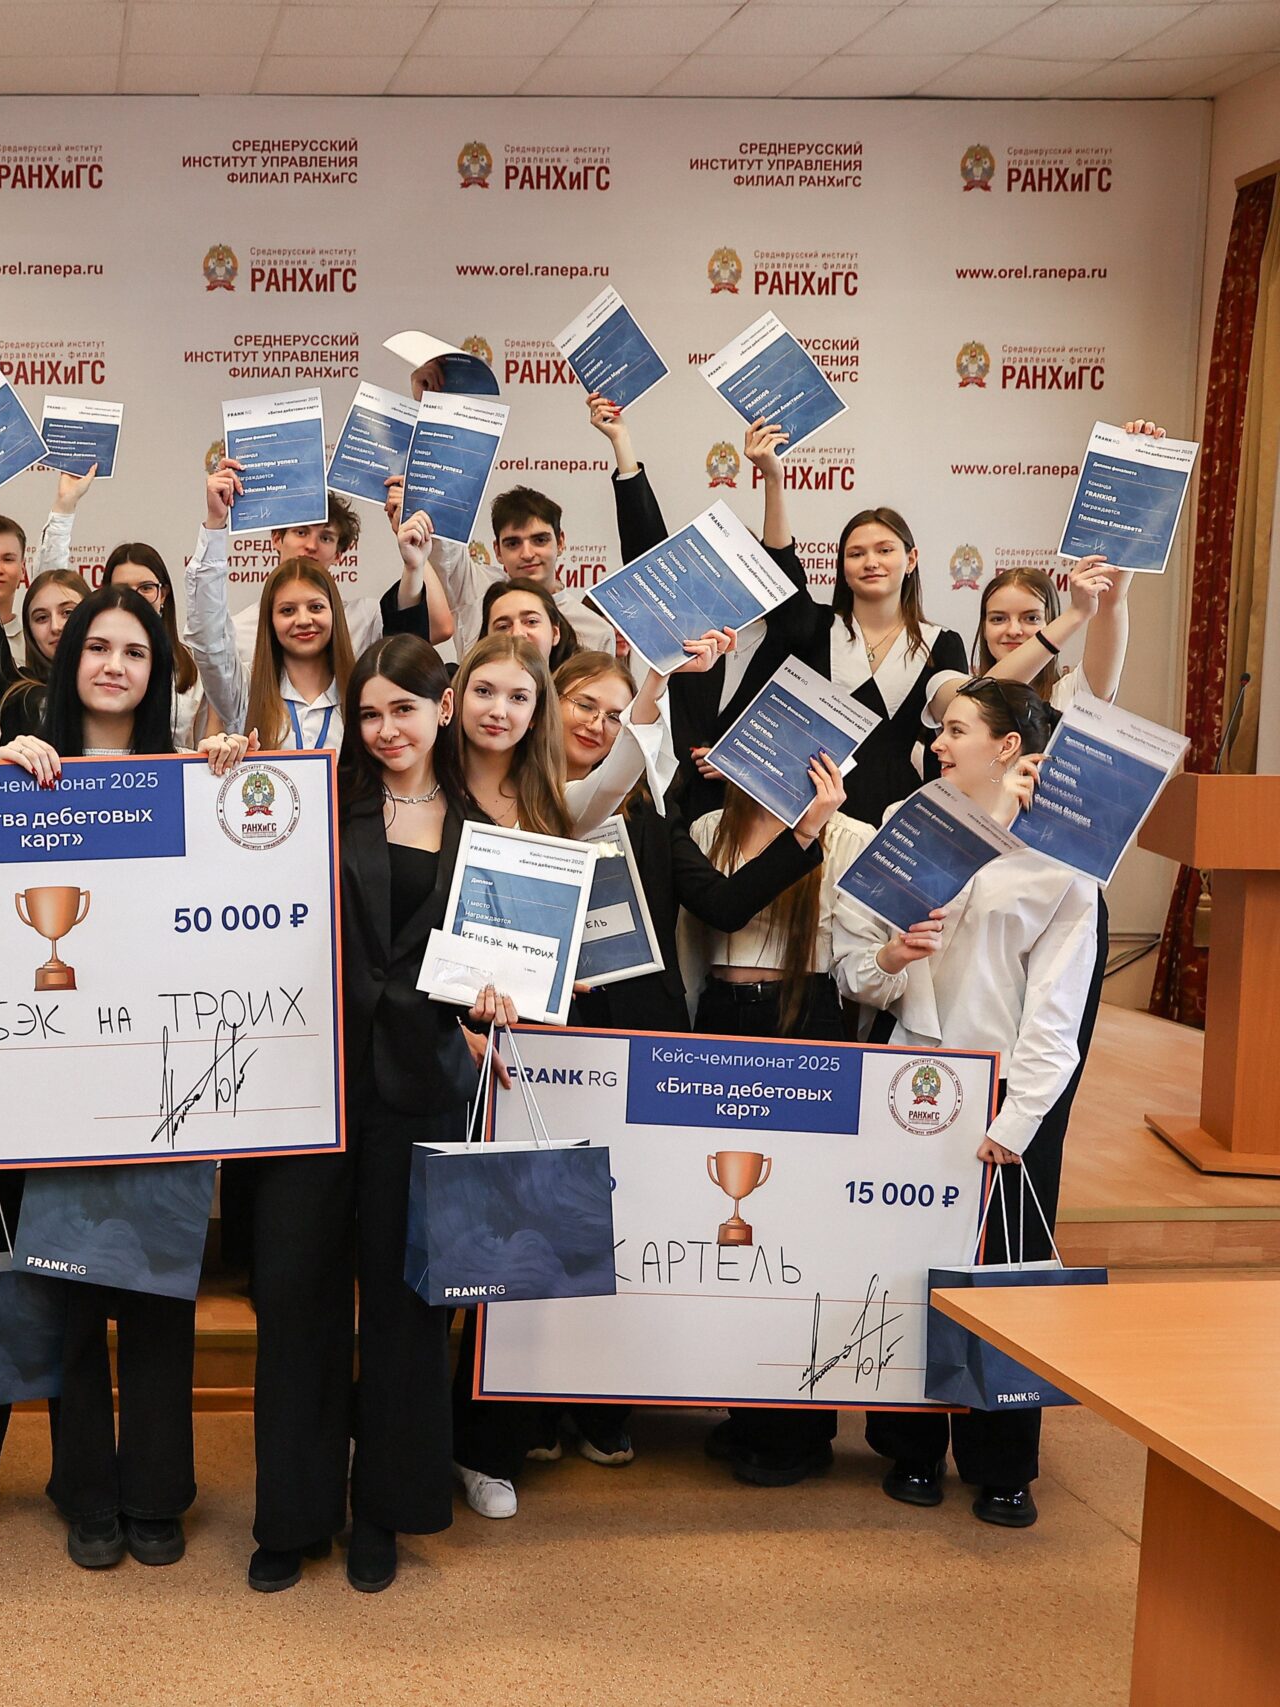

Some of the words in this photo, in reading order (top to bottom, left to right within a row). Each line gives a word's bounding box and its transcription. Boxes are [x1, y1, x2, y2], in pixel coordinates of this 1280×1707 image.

[65, 144, 103, 153] институт
[232, 138, 358, 152] СРЕДНЕРУССКИЙ
[739, 141, 862, 155] СРЕДНЕРУССКИЙ
[65, 156, 103, 164] филиал
[182, 156, 258, 168] ИНСТИТУТ
[261, 156, 358, 168] УПРАВЛЕНИЯ
[690, 159, 764, 171] ИНСТИТУТ
[768, 159, 862, 171] УПРАВЛЕНИЯ
[227, 172, 289, 184] ФИЛИАЛ
[294, 172, 358, 184] РАНХиГС
[504, 166, 610, 191] РАНХиГС
[733, 175, 795, 188] ФИЛИАЛ
[799, 175, 862, 188] РАНХиГС
[1007, 167, 1112, 192] РАНХиГС
[754, 250, 818, 259] Среднерусский
[822, 250, 858, 259] институт
[251, 268, 357, 292] РАНХиГС
[456, 262, 609, 280] www.orel.ranepa.ru
[956, 265, 1107, 281] www.orel.ranepa.ru
[754, 271, 858, 295] РАНХиГС
[234, 332, 359, 347] СРЕДНЕРУССКИЙ
[184, 351, 259, 363] ИНСТИТУТ
[262, 351, 359, 363] УПРАВЛЕНИЯ
[0, 361, 105, 385] РАНХиГС
[228, 367, 290, 379] ФИЛИАЛ
[295, 367, 359, 379] РАНХиГС
[1002, 366, 1104, 390] РАНХиГС
[1087, 480, 1112, 490] Команда
[1081, 502, 1120, 515] Награждается
[708, 512, 723, 531] FRANK
[1078, 514, 1109, 526] Полякова
[655, 556, 679, 583] Картель
[666, 550, 688, 574] Команда
[644, 564, 677, 600] Награждается
[632, 572, 660, 603] Широкова
[657, 598, 676, 620] Мария
[748, 718, 774, 739] Картель
[757, 709, 780, 729] Команда
[740, 728, 777, 756] Награждается
[763, 759, 784, 777] Мария
[110, 772, 159, 790] 2025
[32, 807, 153, 829] дебетовых
[242, 823, 277, 832] РАНХиГС
[20, 832, 83, 851] карт»
[889, 827, 915, 849] Картель
[174, 907, 212, 933] 50
[221, 904, 281, 930] 000
[290, 903, 309, 927] ₽
[465, 910, 512, 924] Награждается
[522, 945, 554, 959] ТРОИХ
[158, 987, 306, 1032] ТРОИХ
[651, 1047, 795, 1071] Кейс-чемпионат
[798, 1055, 841, 1072] 2025
[507, 1066, 583, 1085] FRANK
[588, 1070, 617, 1087] RG
[655, 1078, 723, 1098] «Битва
[727, 1081, 833, 1103] дебетовых
[716, 1098, 771, 1119] карт»
[844, 1181, 874, 1205] 15
[881, 1183, 935, 1207] 000
[941, 1186, 959, 1208] ₽
[27, 1256, 68, 1272] FRANK
[70, 1263, 87, 1275] RG
[445, 1286, 487, 1297] FRANK
[489, 1284, 505, 1296] RG
[997, 1391, 1027, 1404] FRANK
[1027, 1391, 1040, 1402] RG
